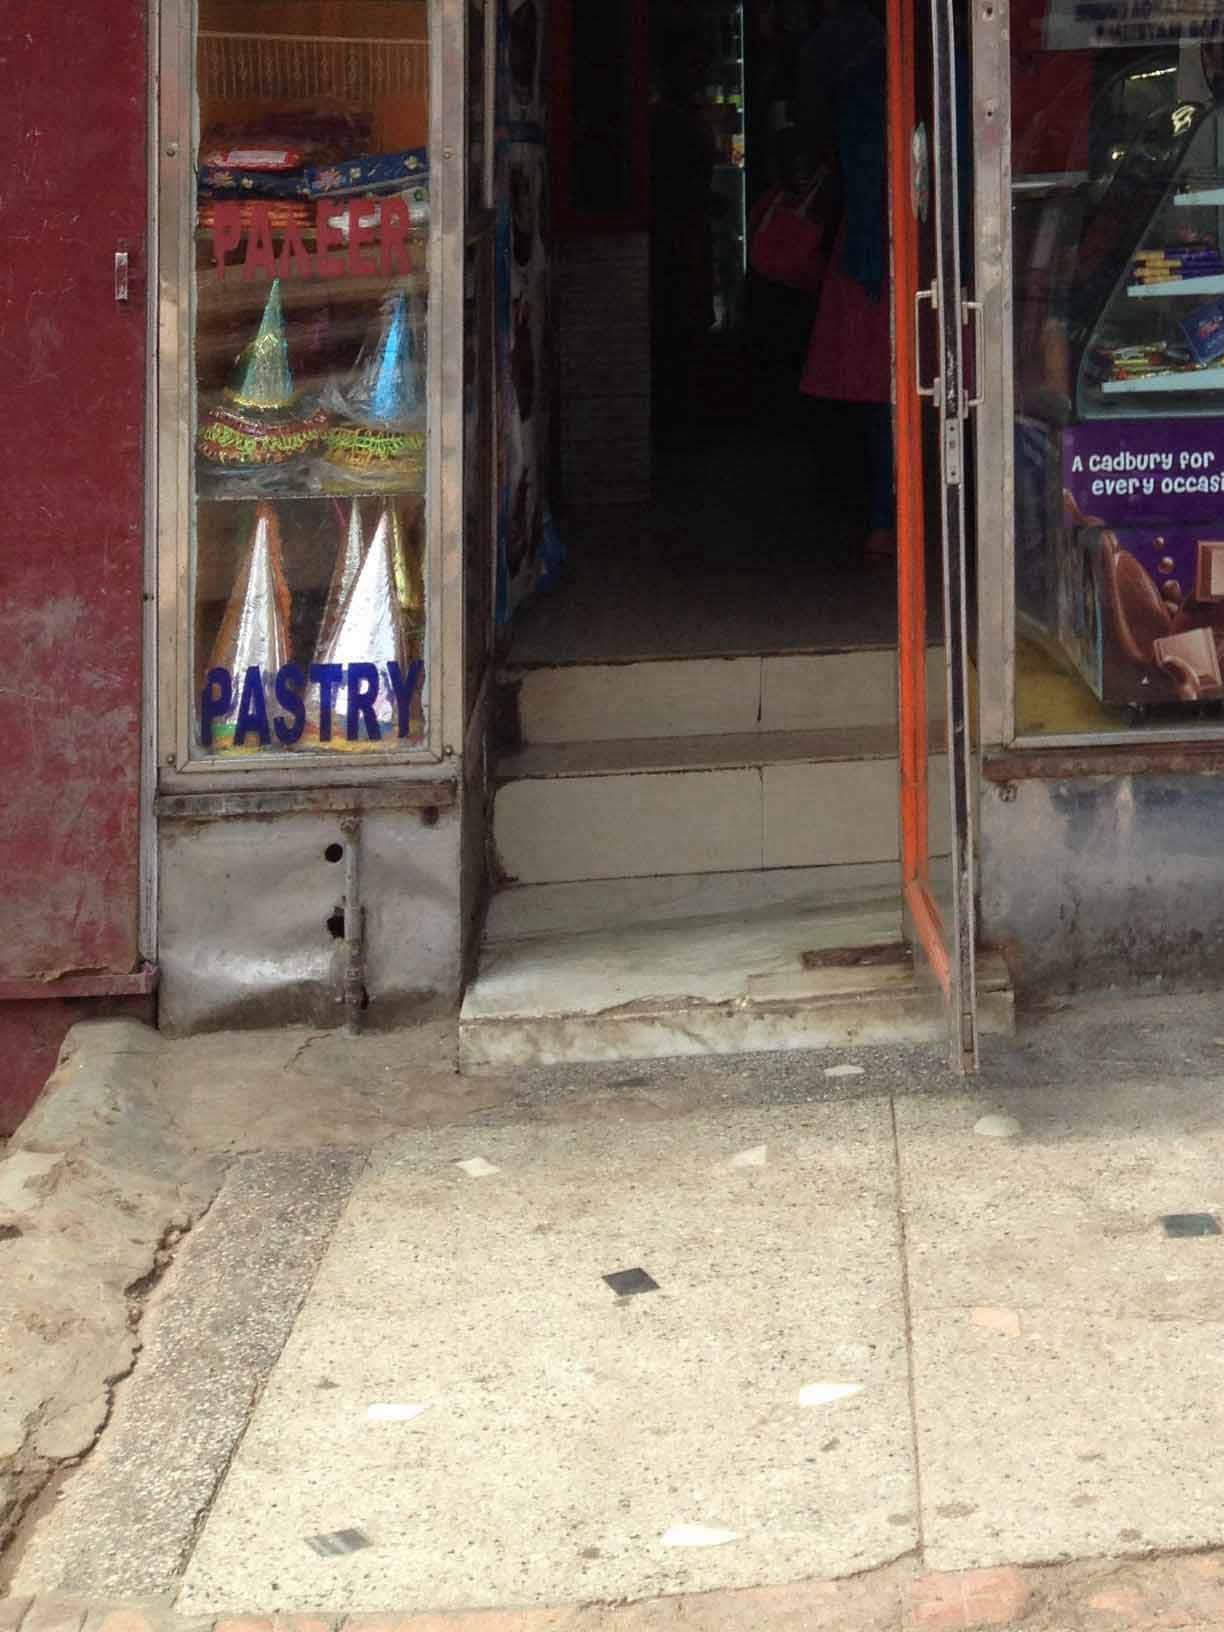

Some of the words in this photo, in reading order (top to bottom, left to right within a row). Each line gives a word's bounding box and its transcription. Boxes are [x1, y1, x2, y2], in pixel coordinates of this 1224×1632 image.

[1072, 454, 1084, 473] A
[1179, 450, 1216, 469] for
[1091, 476, 1155, 497] every
[200, 661, 425, 747] PASTRY
